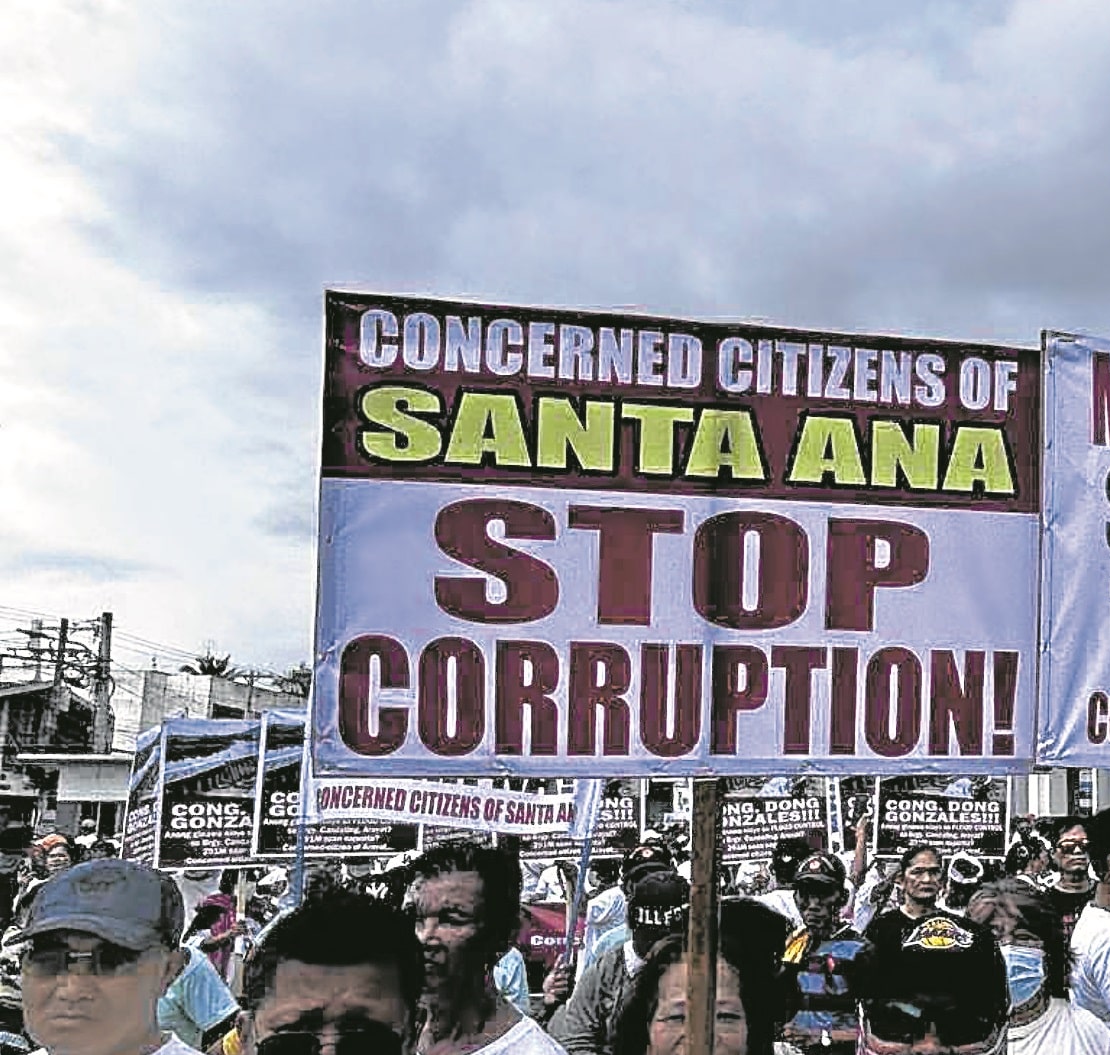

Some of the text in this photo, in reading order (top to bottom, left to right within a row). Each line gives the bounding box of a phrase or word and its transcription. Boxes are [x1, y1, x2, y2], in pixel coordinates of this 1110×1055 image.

[358, 308, 1018, 411] CONCERNED CITIZENS OF
[359, 384, 1017, 496] SANTA ANA
[433, 497, 931, 633] STOP
[337, 632, 1020, 758] CORRUPTION!
[171, 803, 246, 816] CONG.
[409, 789, 480, 820] CITIZENS
[483, 798, 503, 823] OF
[505, 801, 554, 826] SANTA
[722, 809, 820, 828] NZALES!!!
[765, 797, 820, 812] DONG
[884, 811, 1000, 824] GONZALES!!!
[885, 799, 943, 812] CONG.
[949, 800, 1000, 813] DONG
